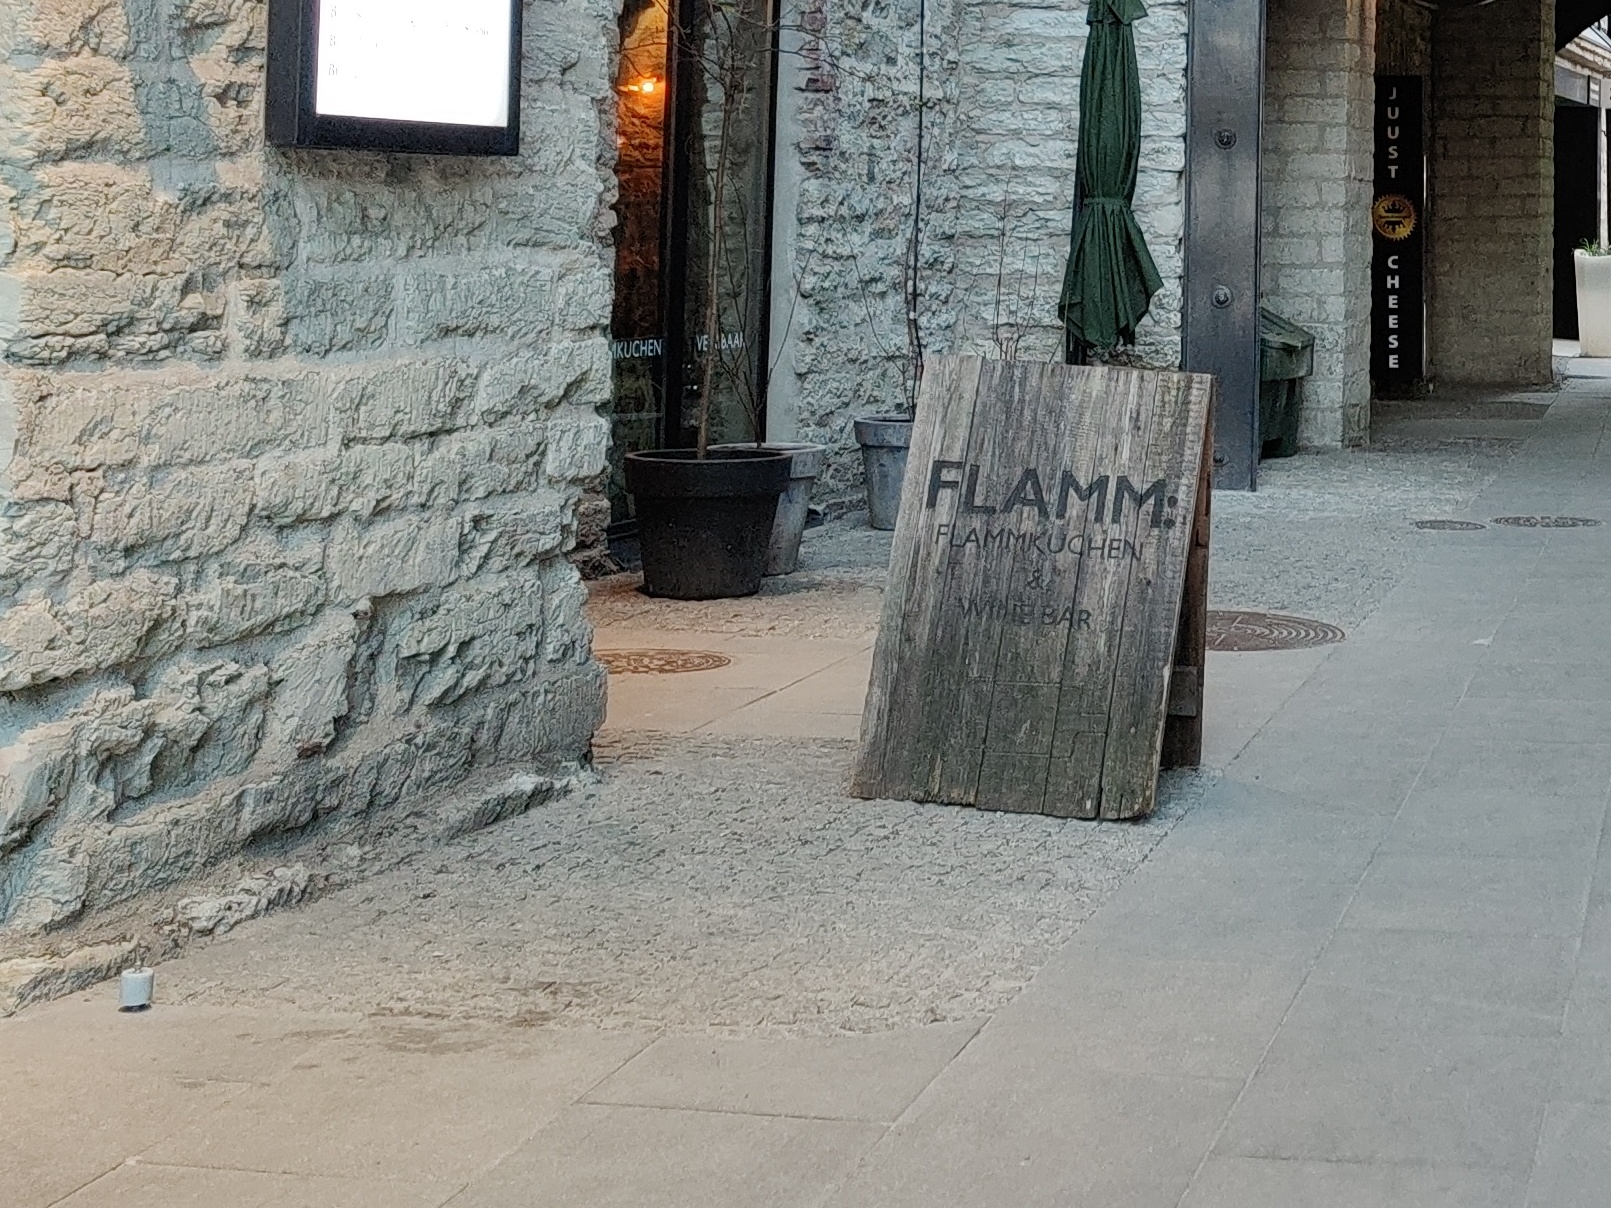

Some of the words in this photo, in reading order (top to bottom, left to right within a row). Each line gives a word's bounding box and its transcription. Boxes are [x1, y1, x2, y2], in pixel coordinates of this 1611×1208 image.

[1386, 255, 1400, 369] CHEESE
[925, 459, 1179, 530] FLAMM:
[935, 523, 1144, 562] FLAMMKUCHEN
[1027, 569, 1044, 590] &
[1041, 605, 1093, 630] BAR
